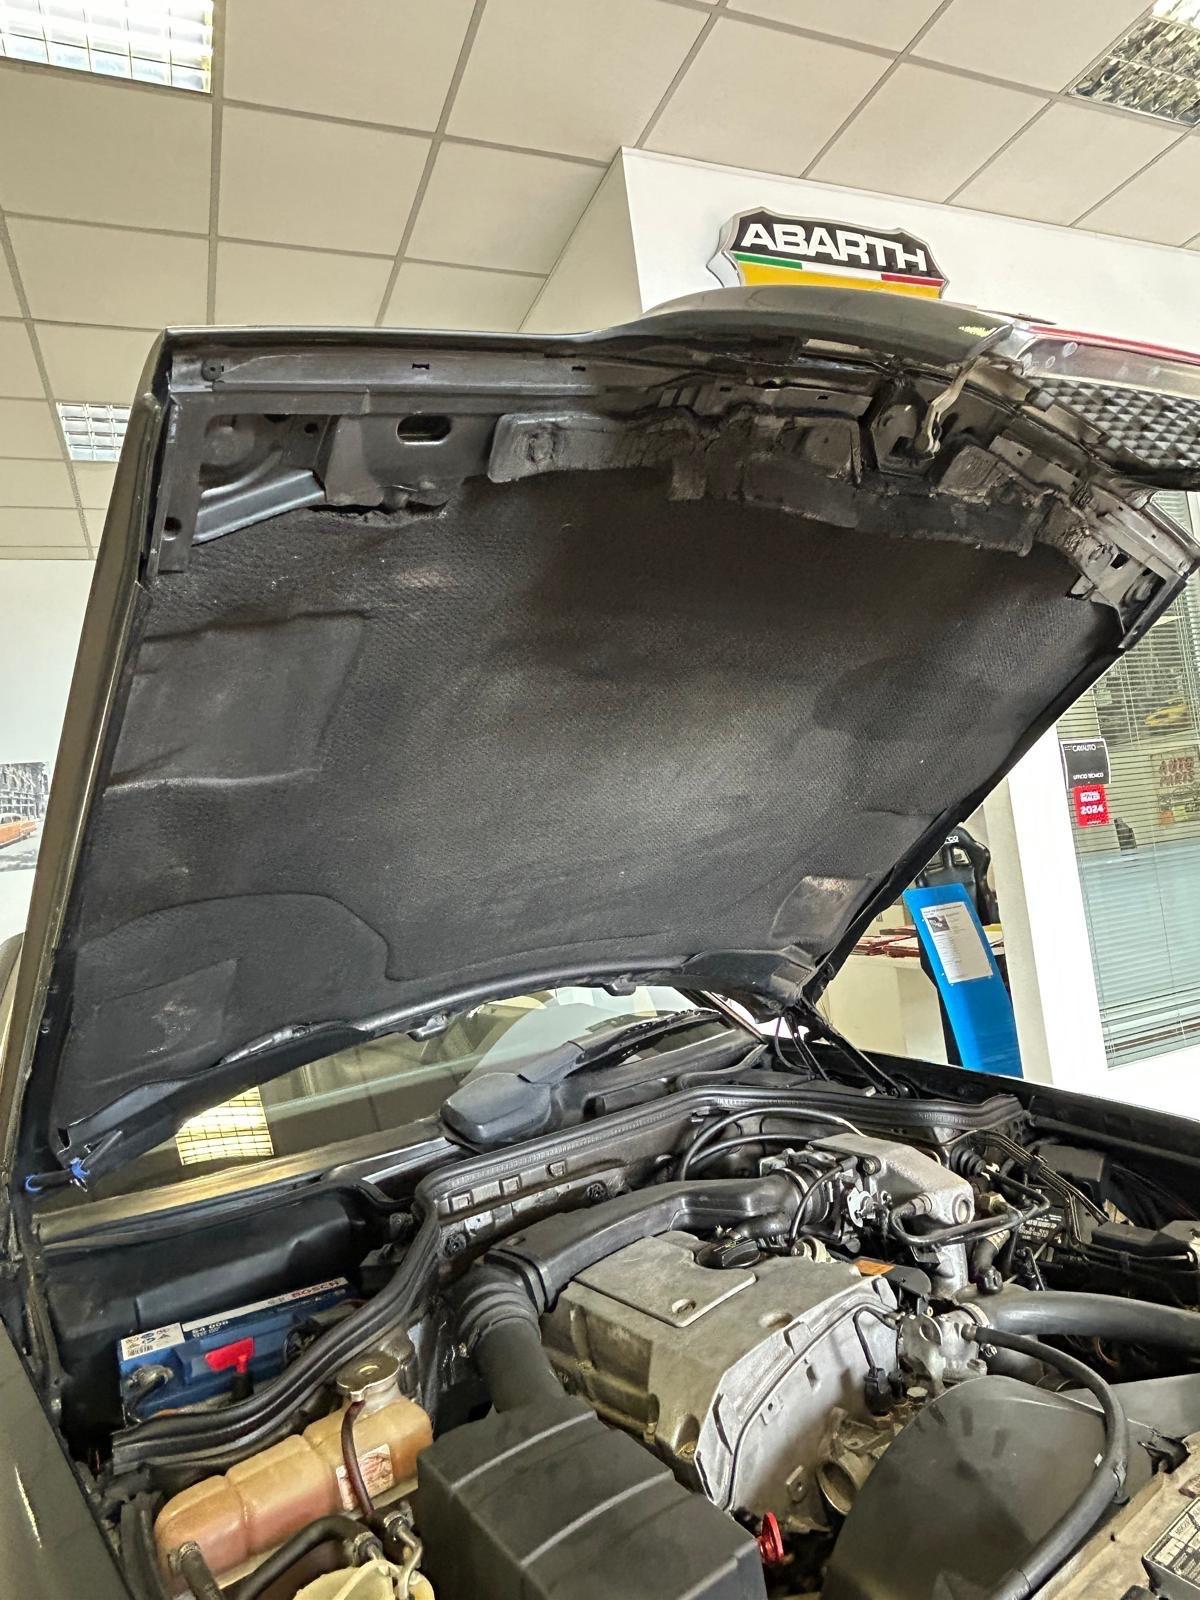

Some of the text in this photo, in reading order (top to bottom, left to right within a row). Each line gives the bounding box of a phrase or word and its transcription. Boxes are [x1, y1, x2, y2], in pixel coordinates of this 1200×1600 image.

[740, 223, 928, 272] ABARTH
[1080, 804, 1105, 815] 2024
[291, 1280, 340, 1298] BOSCH
